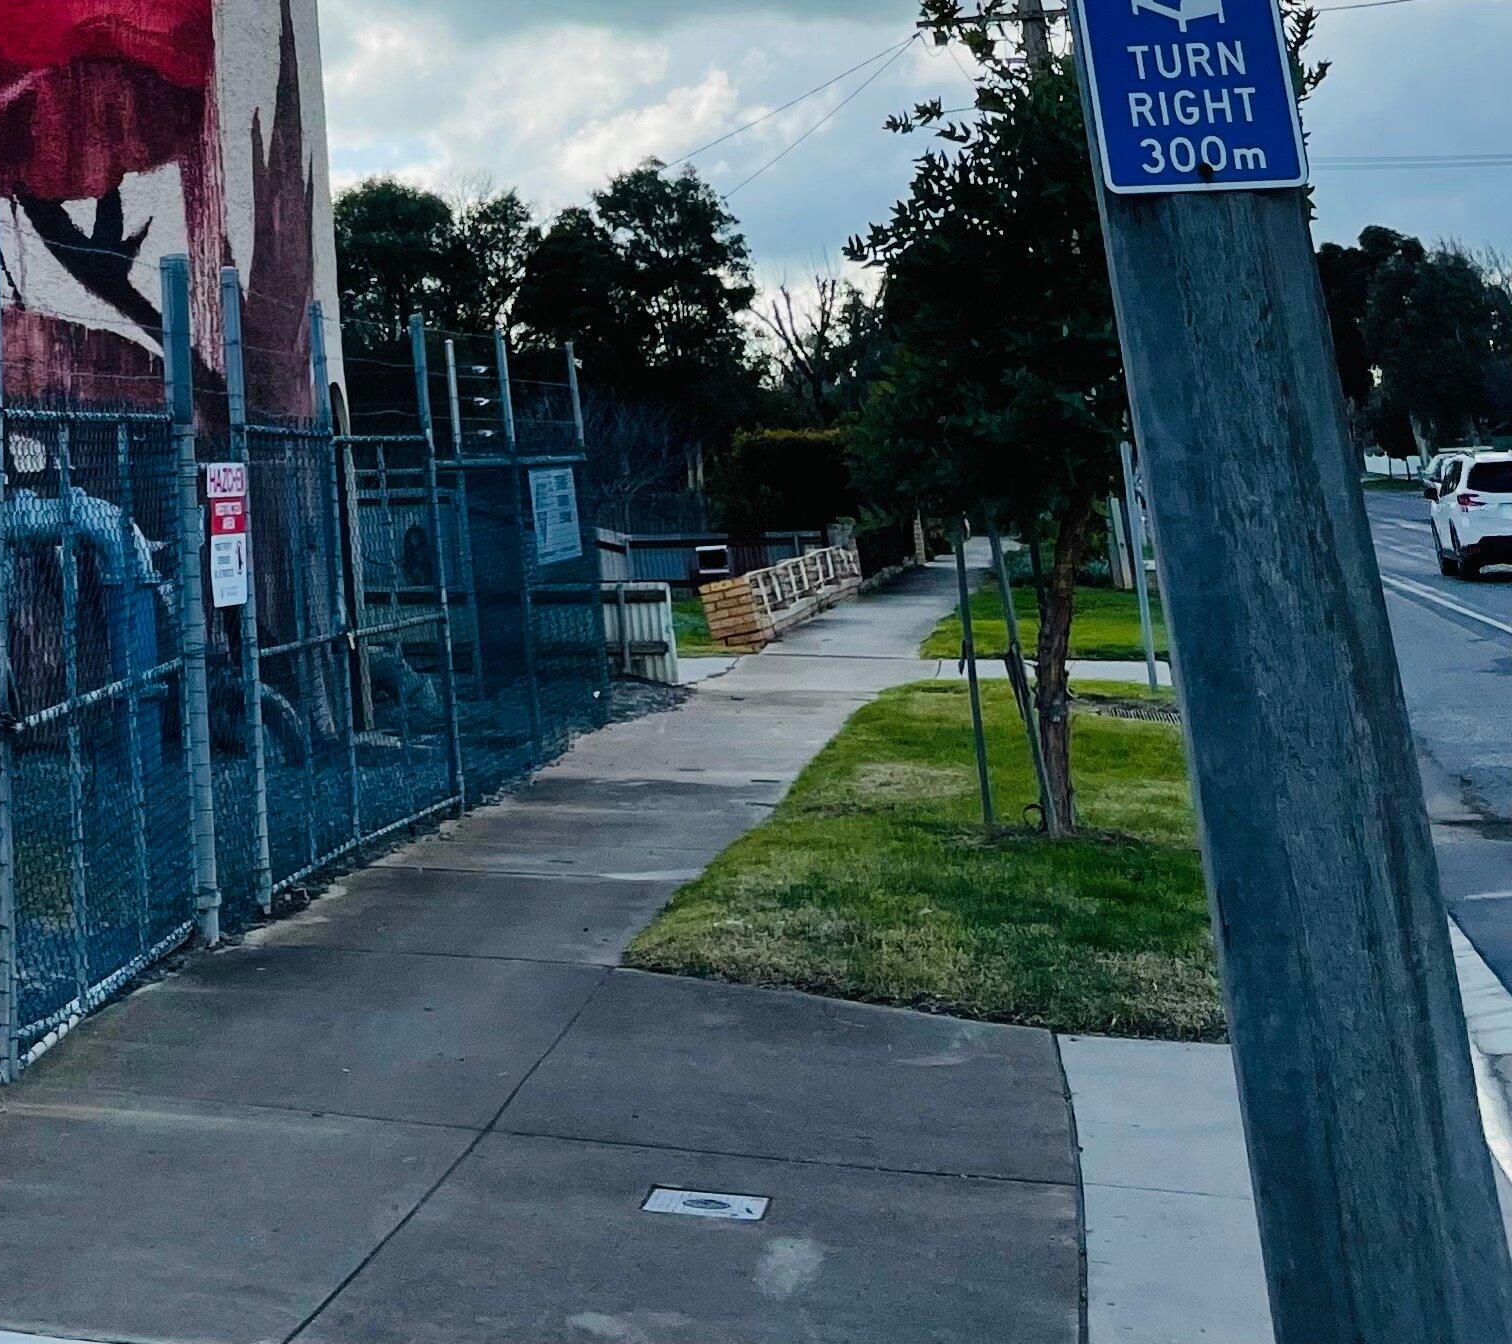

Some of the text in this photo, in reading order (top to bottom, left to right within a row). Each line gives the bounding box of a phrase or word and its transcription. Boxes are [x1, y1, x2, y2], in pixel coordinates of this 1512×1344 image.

[1126, 40, 1247, 80] TURN
[1128, 87, 1256, 127] RIGHT
[1139, 135, 1268, 174] 300m
